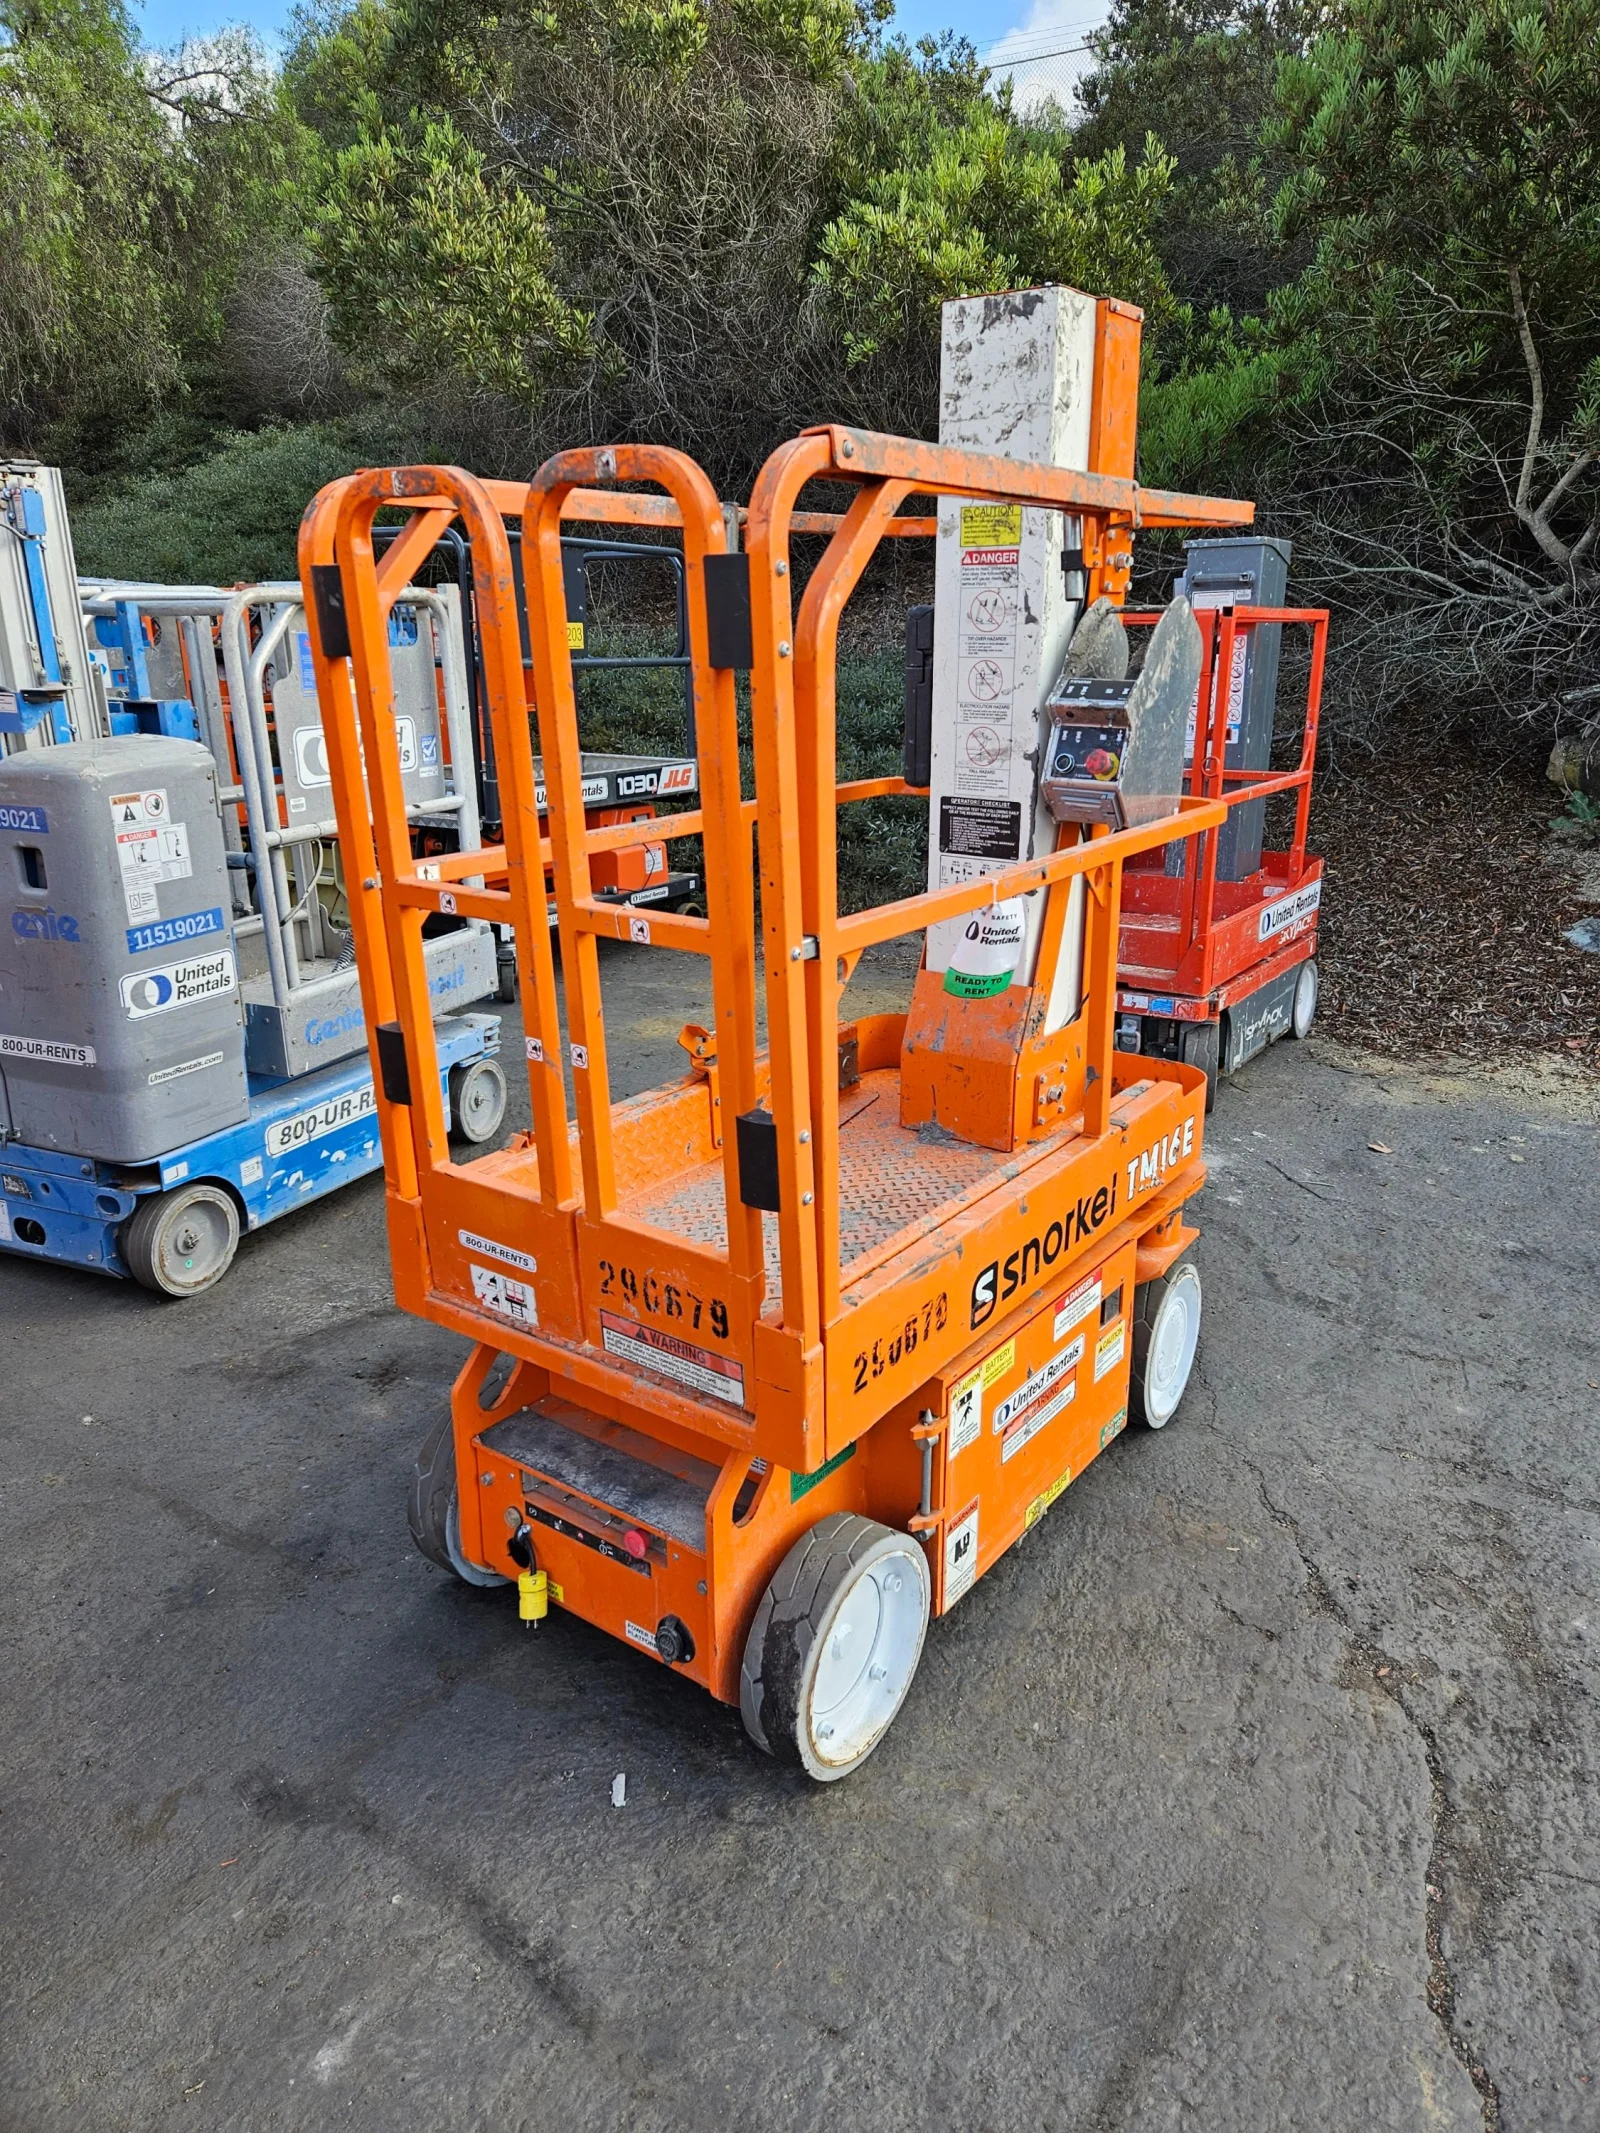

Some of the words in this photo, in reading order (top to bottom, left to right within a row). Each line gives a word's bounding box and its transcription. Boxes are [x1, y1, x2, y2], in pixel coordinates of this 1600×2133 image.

[973, 505, 1014, 517] CAUTION
[972, 552, 1017, 564] DANGER
[617, 773, 658, 796] 1030
[663, 768, 692, 789] JLG
[128, 831, 153, 841] DANGER
[1272, 902, 1295, 927] United
[1296, 888, 1318, 913] Rentals
[134, 913, 218, 950] 11519021
[980, 935, 1021, 946] Rentals
[982, 925, 1021, 936] United
[175, 957, 225, 984] United
[955, 975, 987, 985] READY
[991, 977, 1003, 985] TO
[177, 974, 231, 1000] Rentals
[964, 987, 991, 995] RENT
[2, 1038, 87, 1062] 800-UR-RENTS
[149, 1054, 222, 1083] UnitedRentals.com
[280, 1090, 375, 1146] 800-UR-R
[1001, 1172, 1118, 1301] snorkel
[465, 1236, 529, 1267] 800-UR-RENTS
[1069, 1275, 1095, 1303] DANGER
[650, 1331, 706, 1364] WARNING
[985, 1346, 1011, 1374] BATTERY
[957, 1371, 981, 1396] CAUTION
[1012, 1371, 1045, 1412] United
[1047, 1345, 1079, 1379] Rentals
[953, 1500, 978, 1528] WARNING
[628, 1622, 649, 1636] POWER
[628, 1629, 657, 1647] PLATFOR
